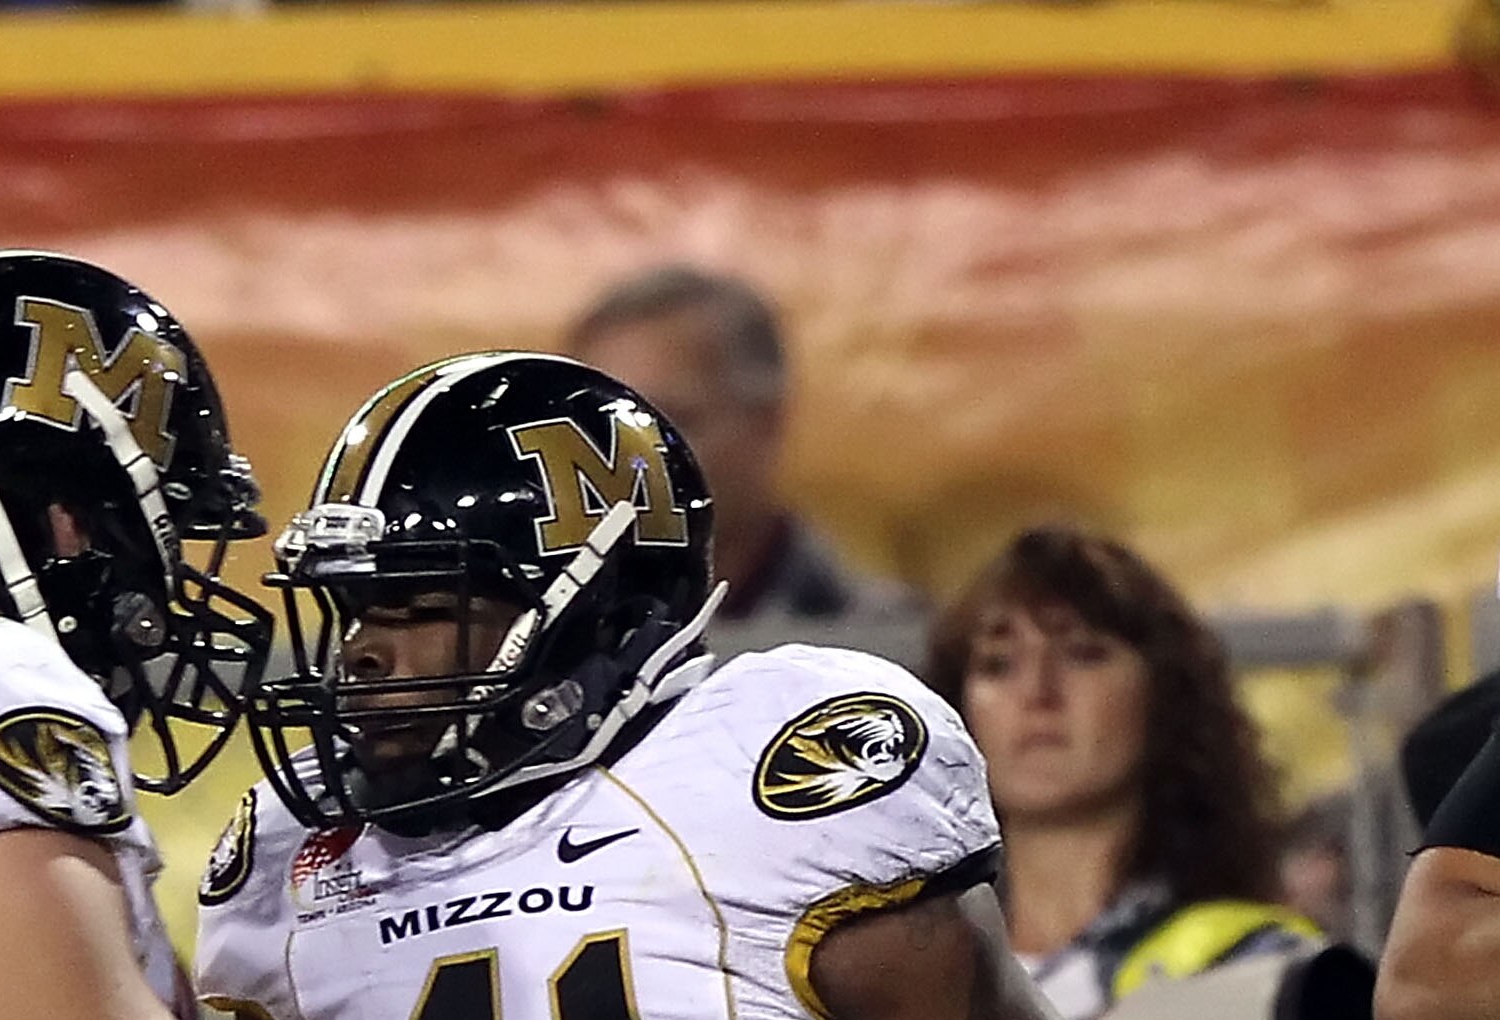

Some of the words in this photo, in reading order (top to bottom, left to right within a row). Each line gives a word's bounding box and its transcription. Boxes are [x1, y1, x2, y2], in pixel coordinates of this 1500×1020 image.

[0, 295, 188, 473] M
[506, 416, 688, 557] M
[379, 885, 595, 945] MIZZOU
